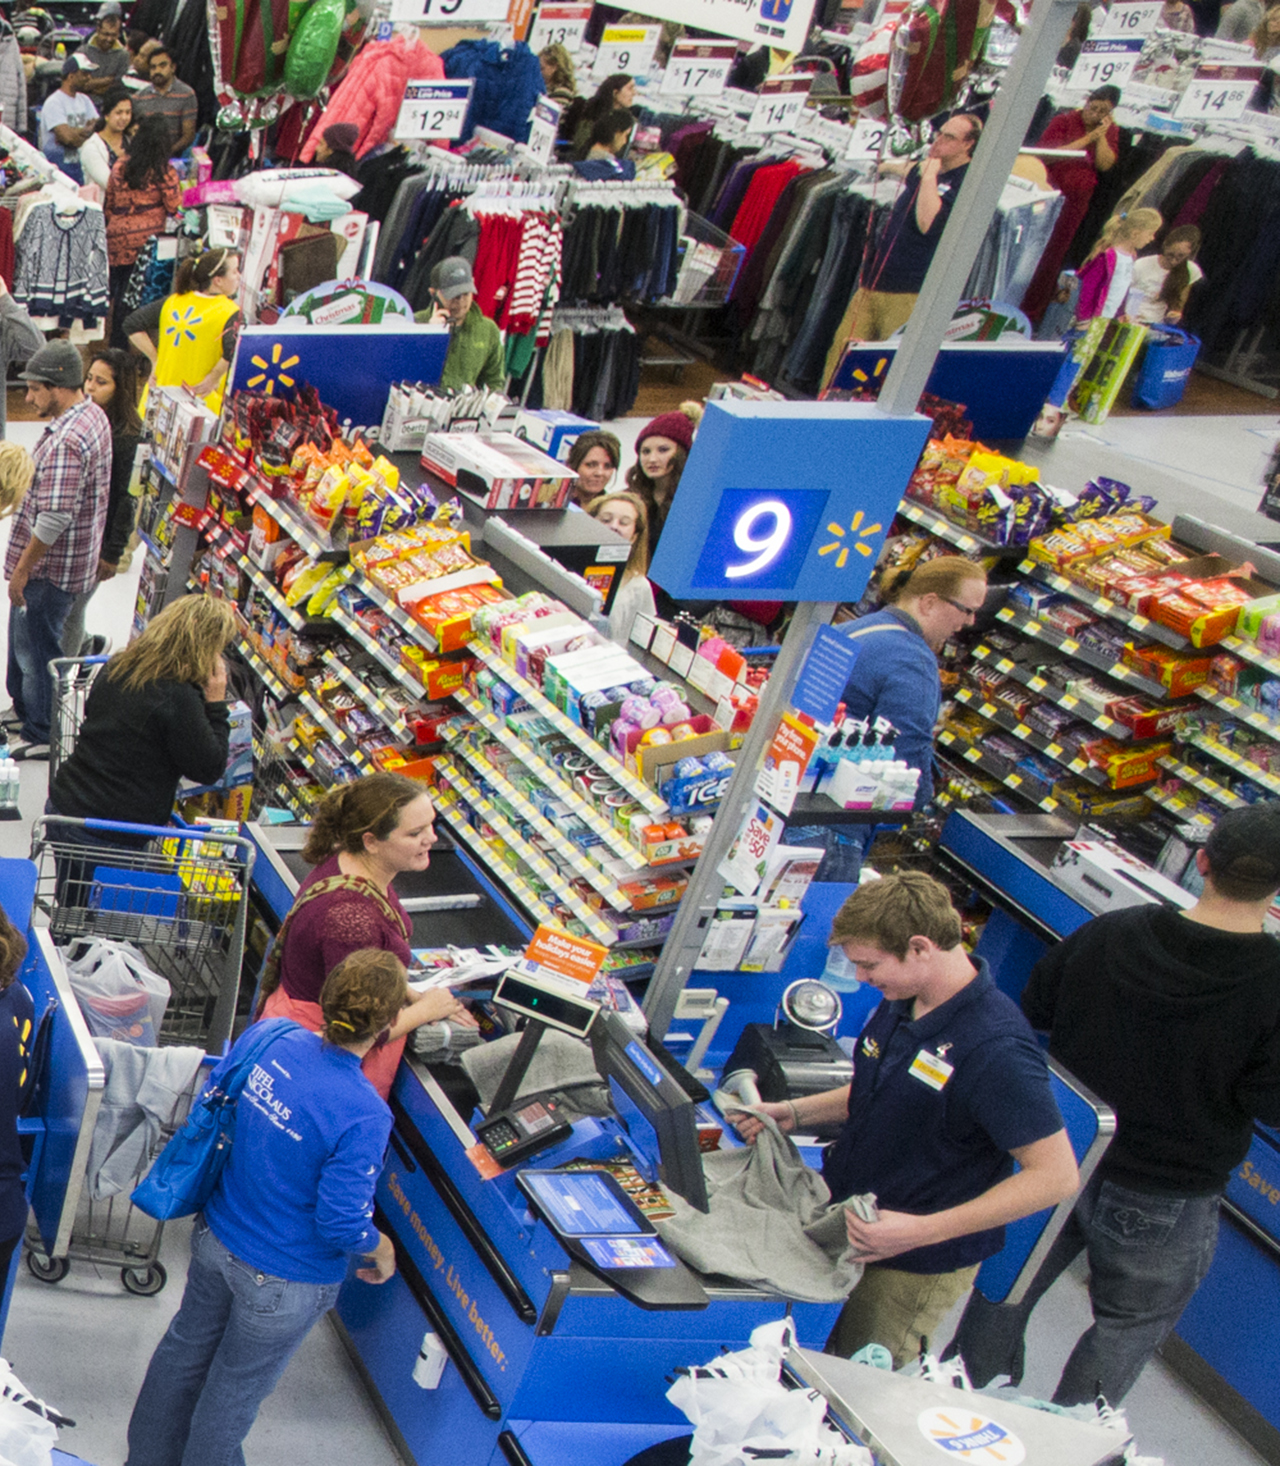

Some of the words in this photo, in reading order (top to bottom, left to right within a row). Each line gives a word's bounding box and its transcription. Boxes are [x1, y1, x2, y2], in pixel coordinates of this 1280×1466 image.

[724, 500, 792, 578] 9
[746, 818, 771, 845] Save
[1238, 1161, 1280, 1206] Save
[386, 1173, 411, 1216] Save
[408, 1213, 445, 1274] money.
[445, 1268, 470, 1311] Live
[468, 1300, 508, 1372] better.
